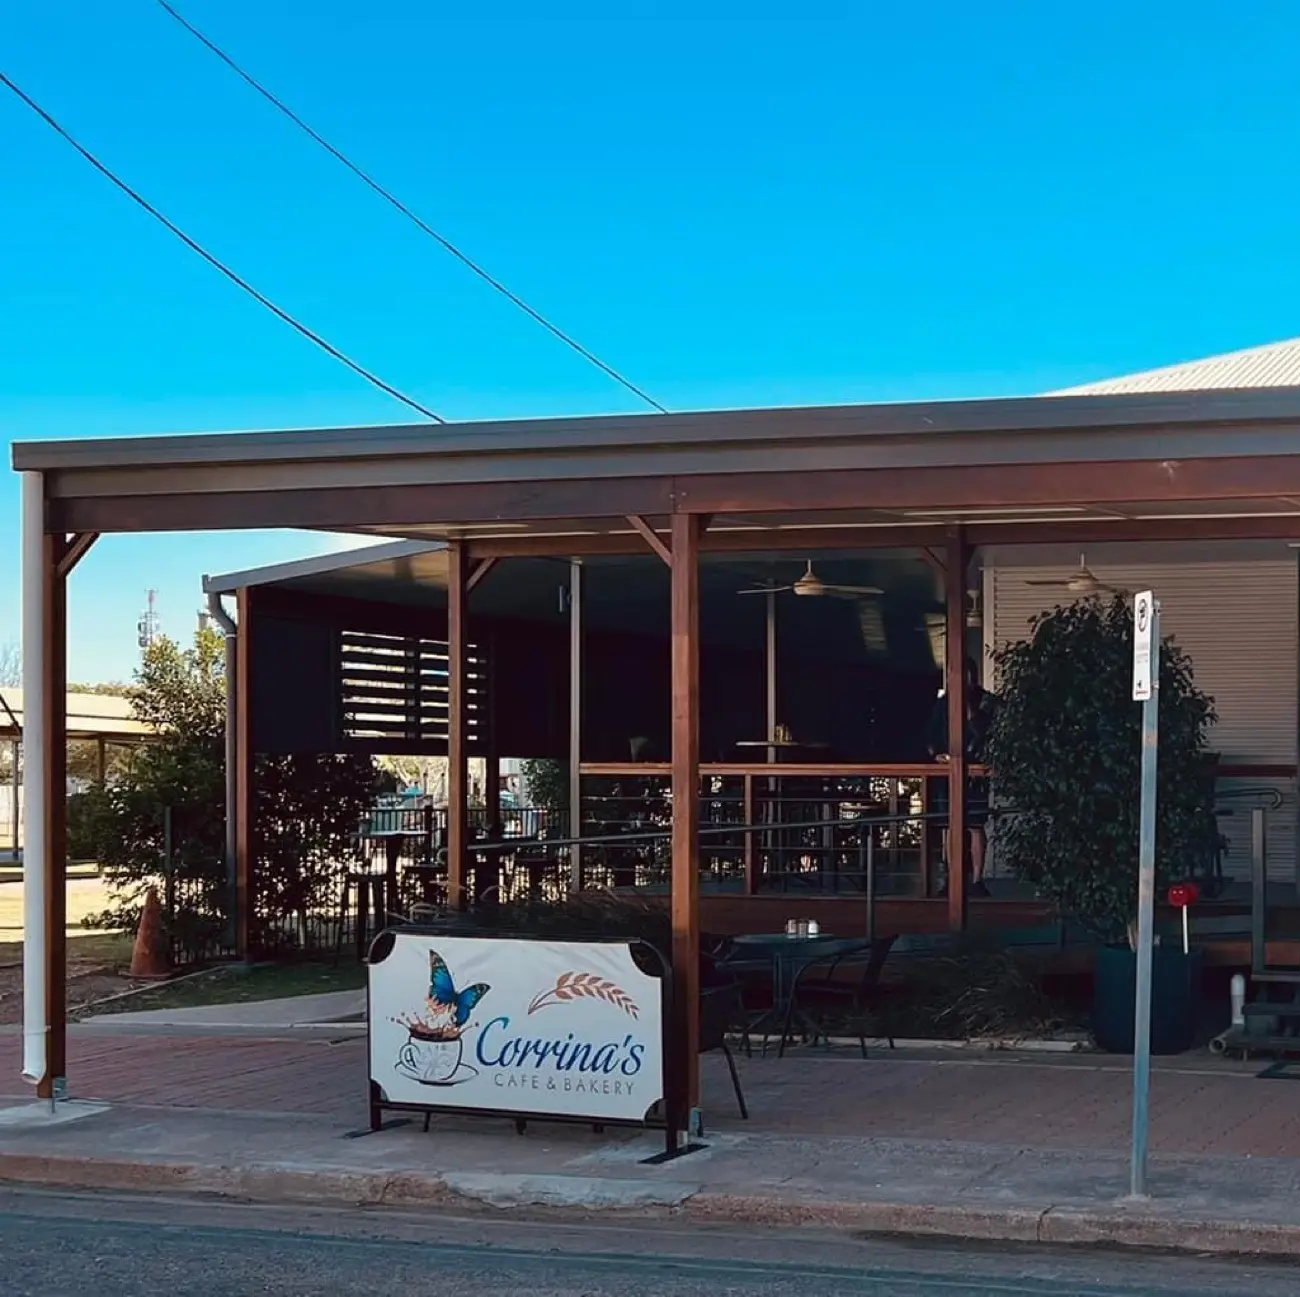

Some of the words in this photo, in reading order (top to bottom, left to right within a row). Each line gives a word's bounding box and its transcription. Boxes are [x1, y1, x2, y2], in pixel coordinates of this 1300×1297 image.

[476, 1016, 645, 1076] Corrina's
[494, 1073, 540, 1090] CAFE
[546, 1076, 557, 1091] &
[563, 1077, 635, 1096] BAKERY
